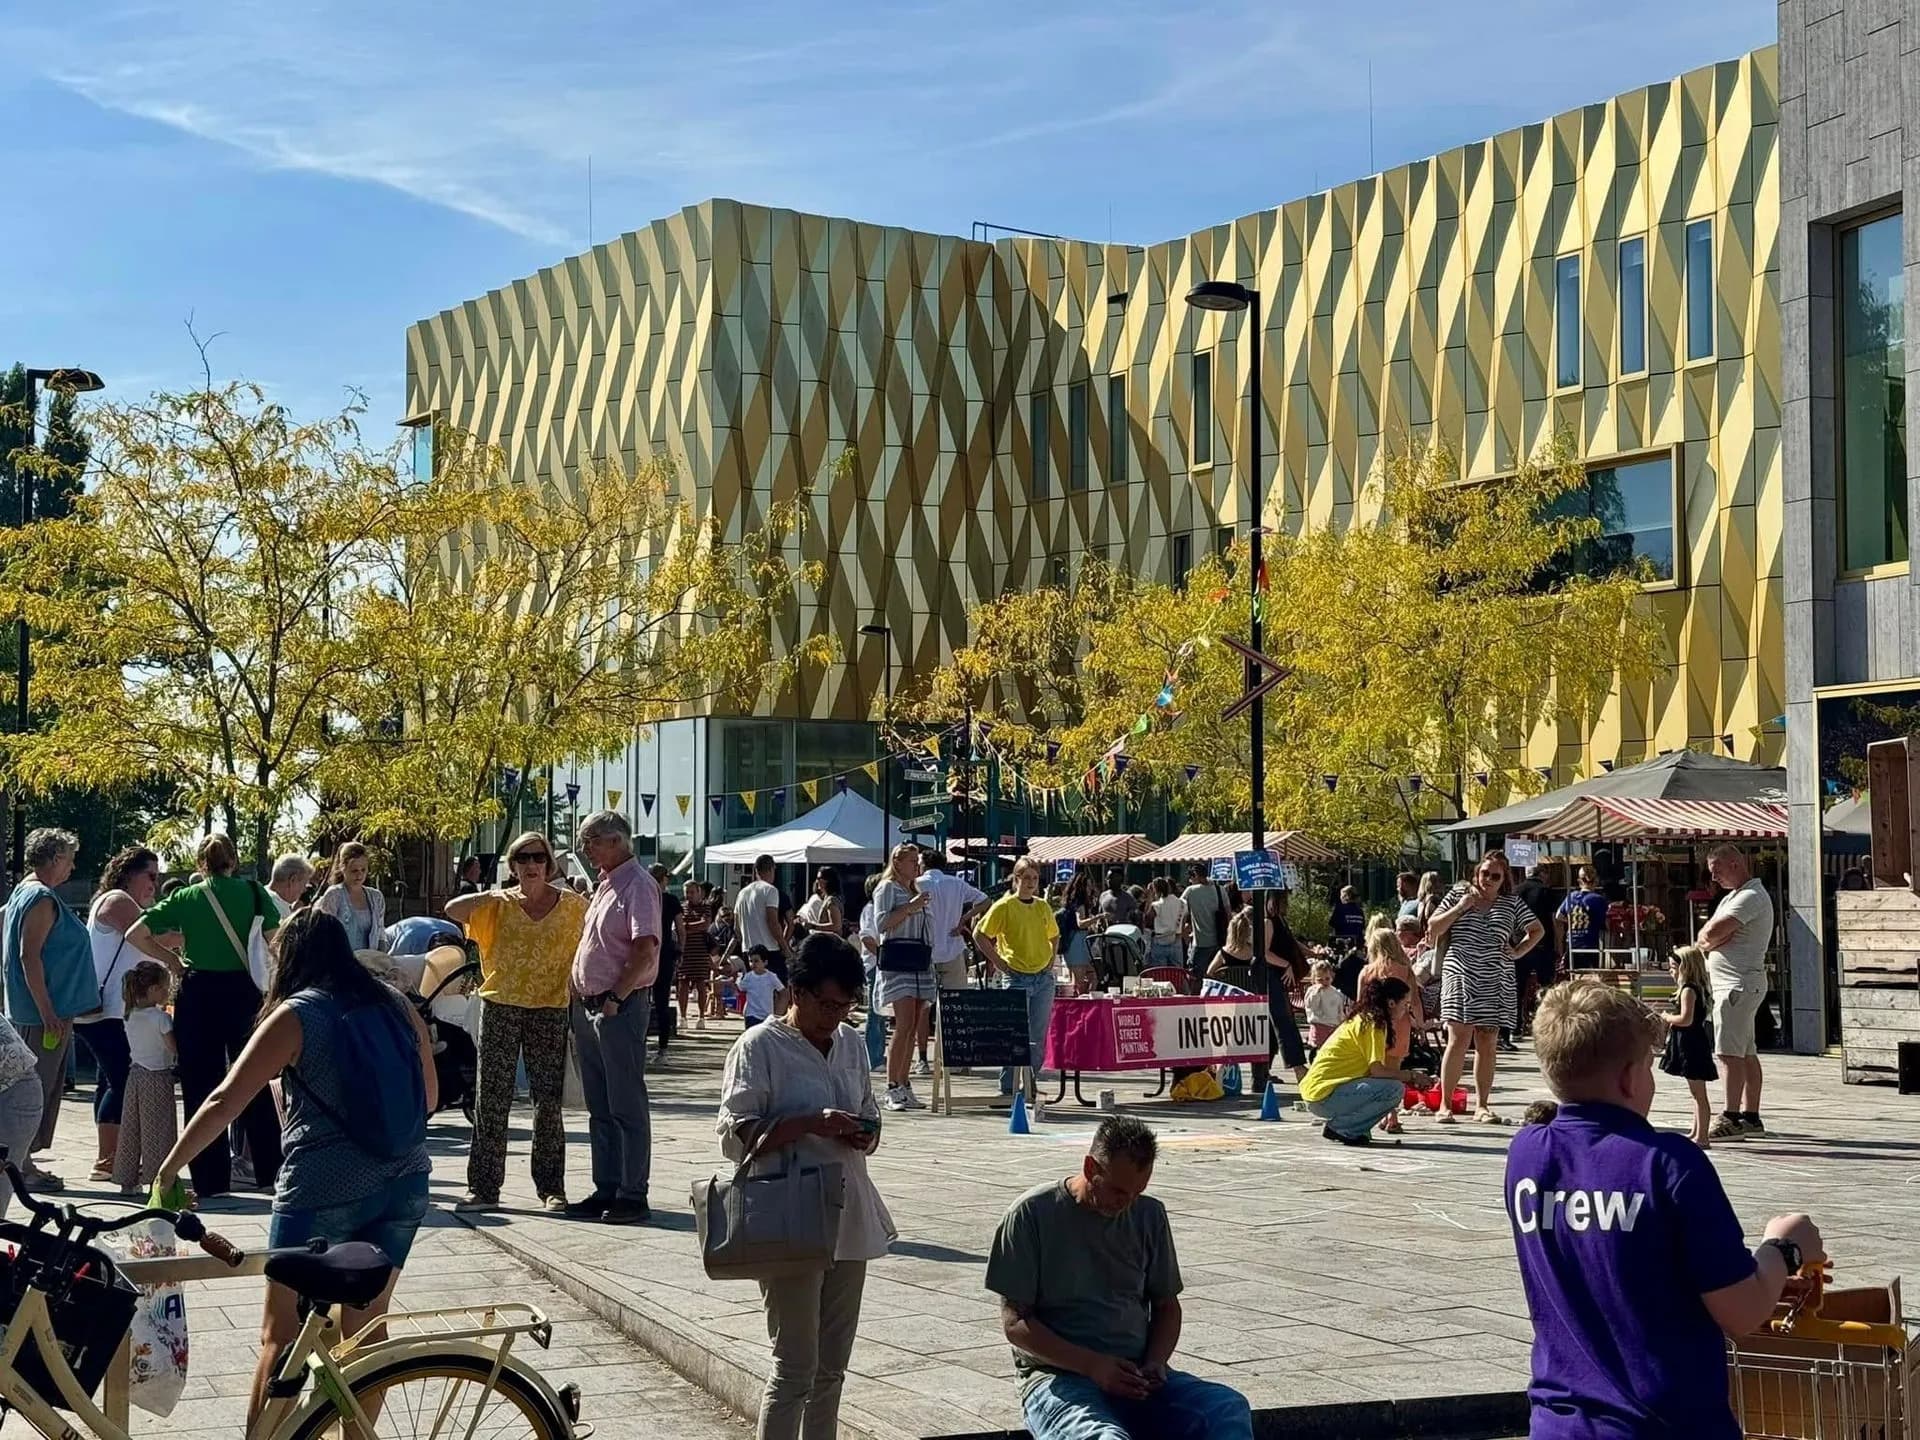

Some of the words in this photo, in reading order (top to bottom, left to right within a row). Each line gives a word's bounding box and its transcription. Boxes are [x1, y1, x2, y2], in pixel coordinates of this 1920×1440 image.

[1117, 1014, 1141, 1026] WORLD
[1119, 1028, 1142, 1041] STREET
[1178, 1015, 1268, 1049] INFOPUNT
[1120, 1041, 1149, 1054] PAINTING
[1514, 1177, 1645, 1233] Crew
